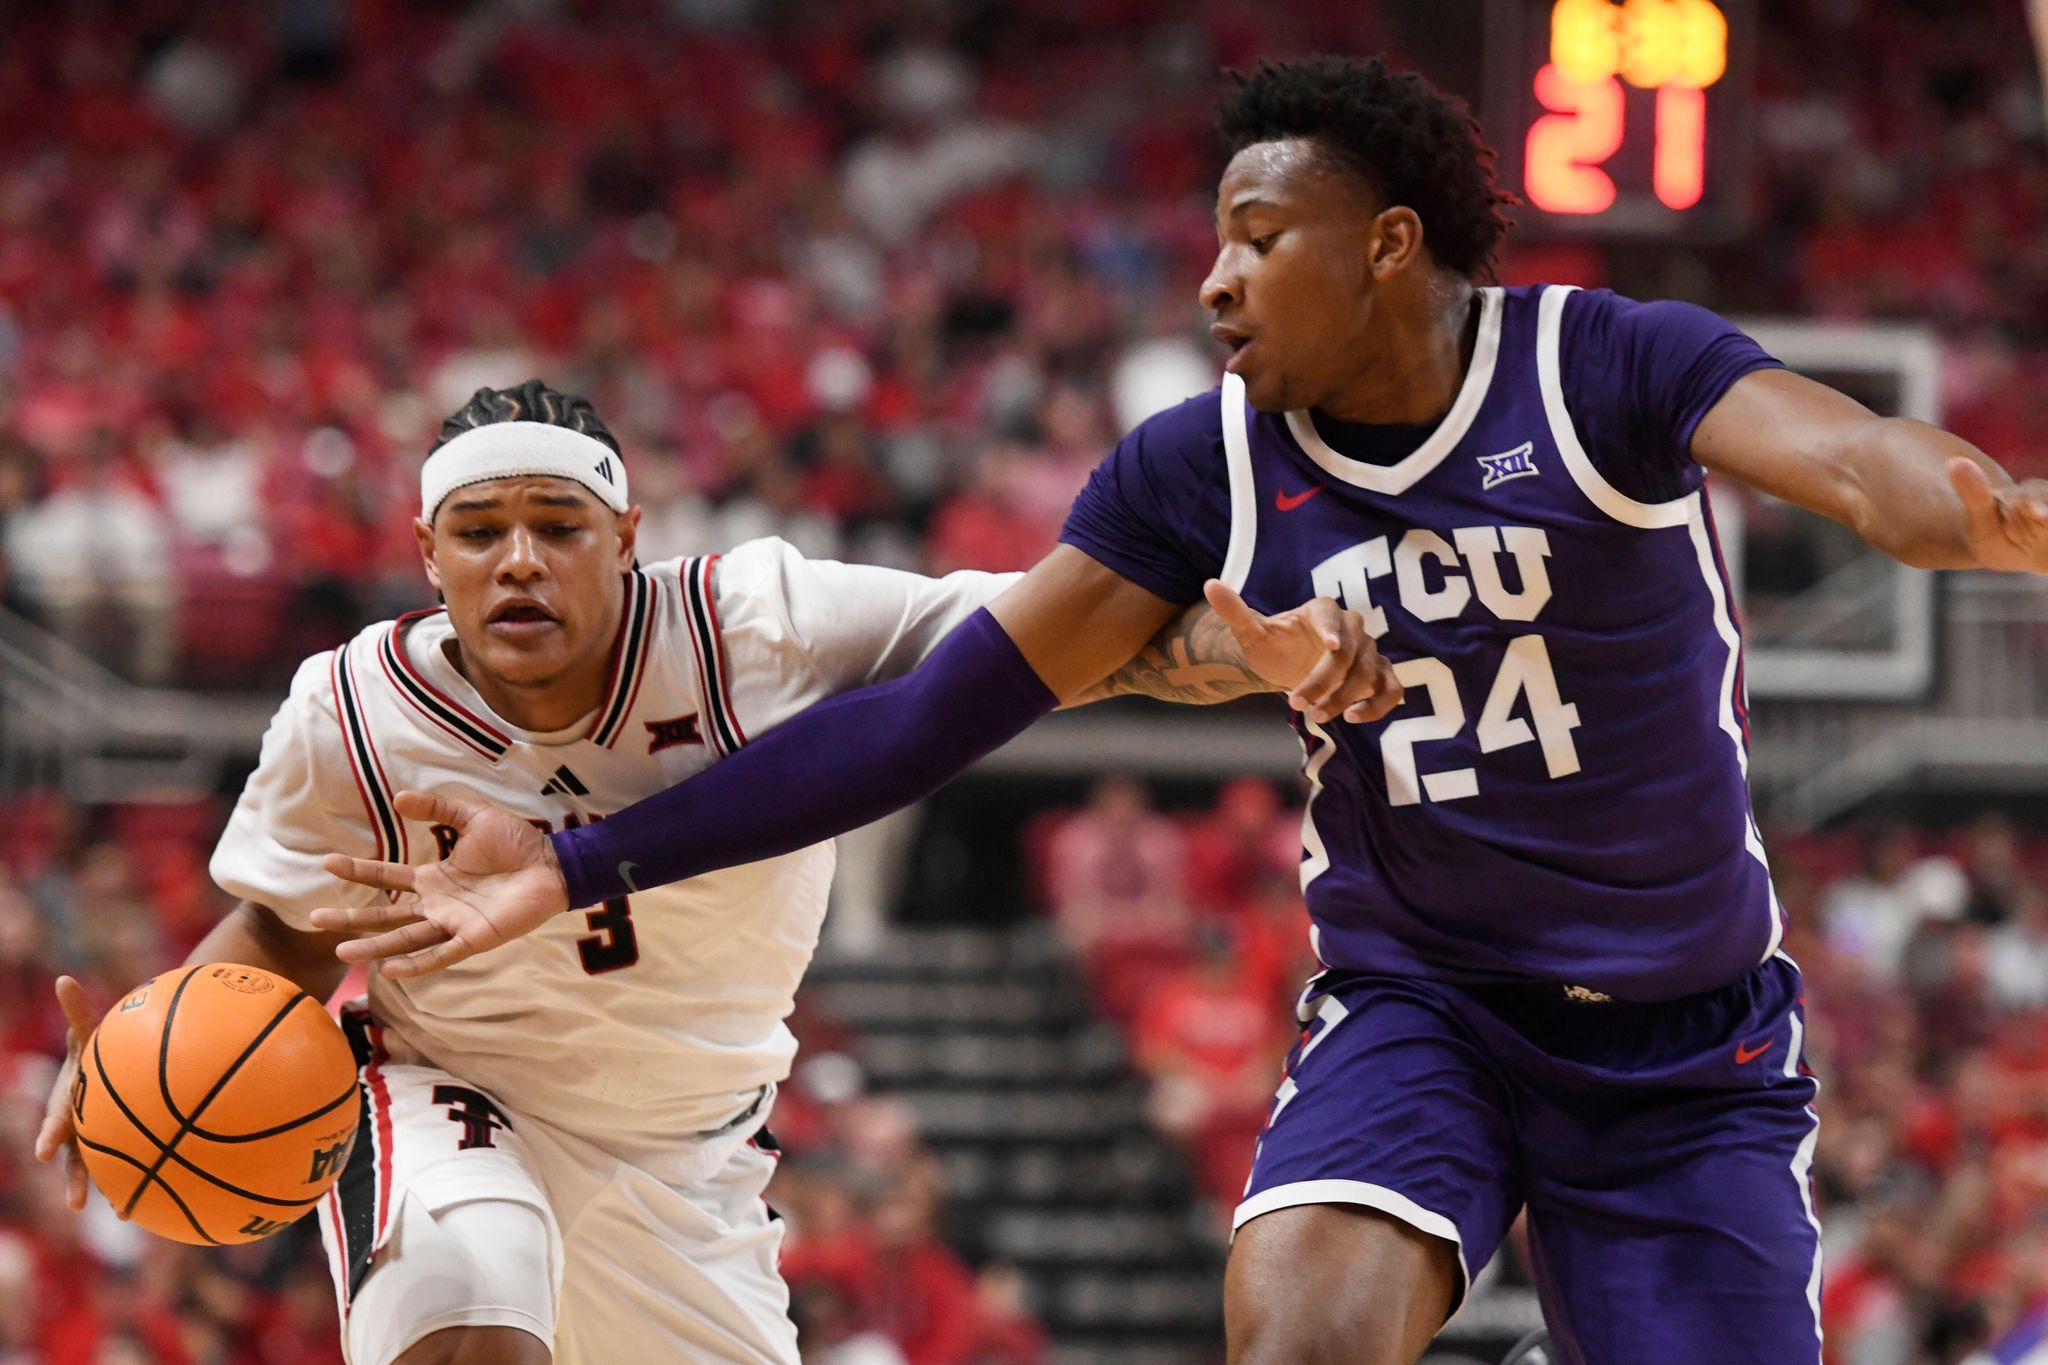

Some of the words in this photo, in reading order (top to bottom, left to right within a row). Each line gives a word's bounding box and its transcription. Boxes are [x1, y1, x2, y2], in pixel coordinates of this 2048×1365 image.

[1524, 64, 1706, 213] 21
[1476, 440, 1540, 490] XII
[1311, 526, 1553, 640] TCU
[1379, 634, 1582, 807] 24
[577, 894, 640, 976] 3
